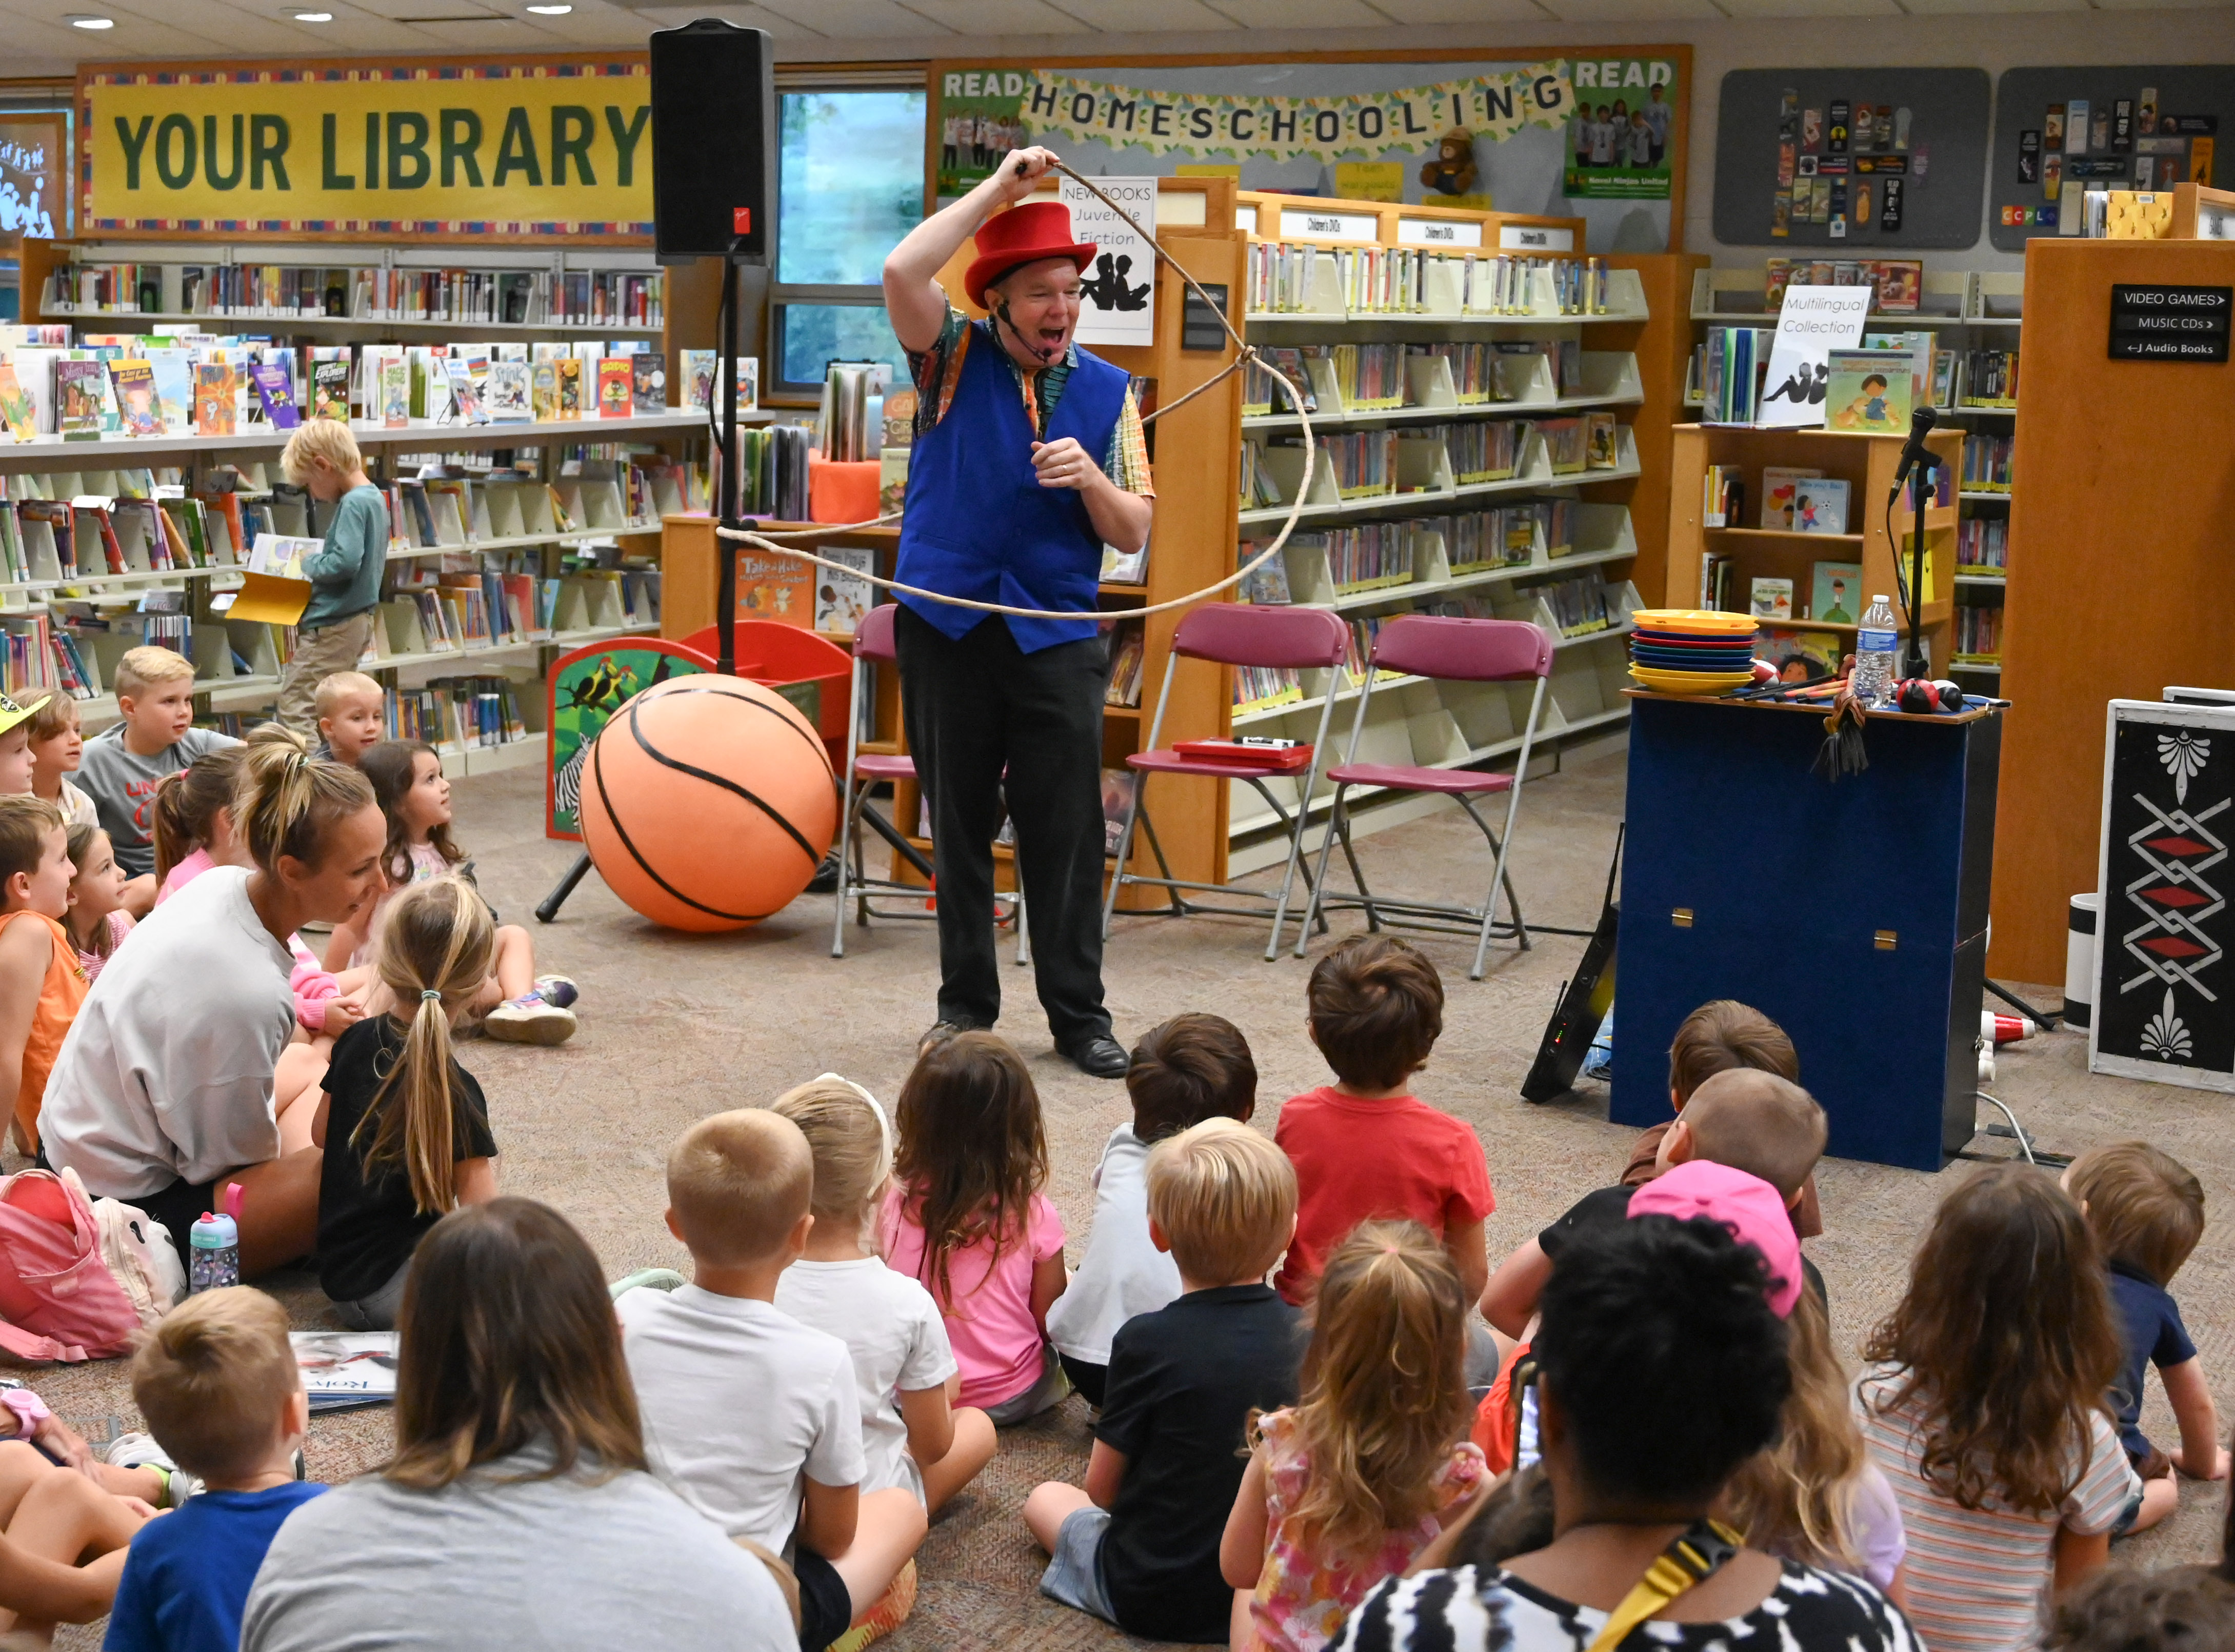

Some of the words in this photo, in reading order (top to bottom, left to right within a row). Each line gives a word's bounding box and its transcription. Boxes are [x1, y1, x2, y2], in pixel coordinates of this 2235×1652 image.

[1576, 62, 1672, 88] READ
[945, 73, 1023, 97] READ
[1031, 75, 1561, 143] HOMESCHOOLING
[115, 113, 290, 190] YOUR
[322, 106, 651, 190] LIBRARY
[1065, 188, 1096, 200] NEW
[1101, 187, 1151, 201] BOOKS
[1075, 208, 1140, 221] Juvenle
[1308, 217, 1328, 231] Children's
[1329, 219, 1340, 232] DVDs
[1080, 232, 1134, 245] Fiction
[1426, 226, 1443, 239] Children's
[1785, 296, 1865, 313] Multilingual
[2125, 293, 2164, 304] VIDEO
[2168, 294, 2216, 306] GAMES
[1784, 321, 1854, 334] Collection
[2139, 318, 2178, 328] MUSIC
[2182, 319, 2203, 329] CDs
[2145, 344, 2177, 353] Audio
[2181, 344, 2213, 353] Books
[495, 366, 525, 383] Stink
[741, 557, 770, 574] Take
